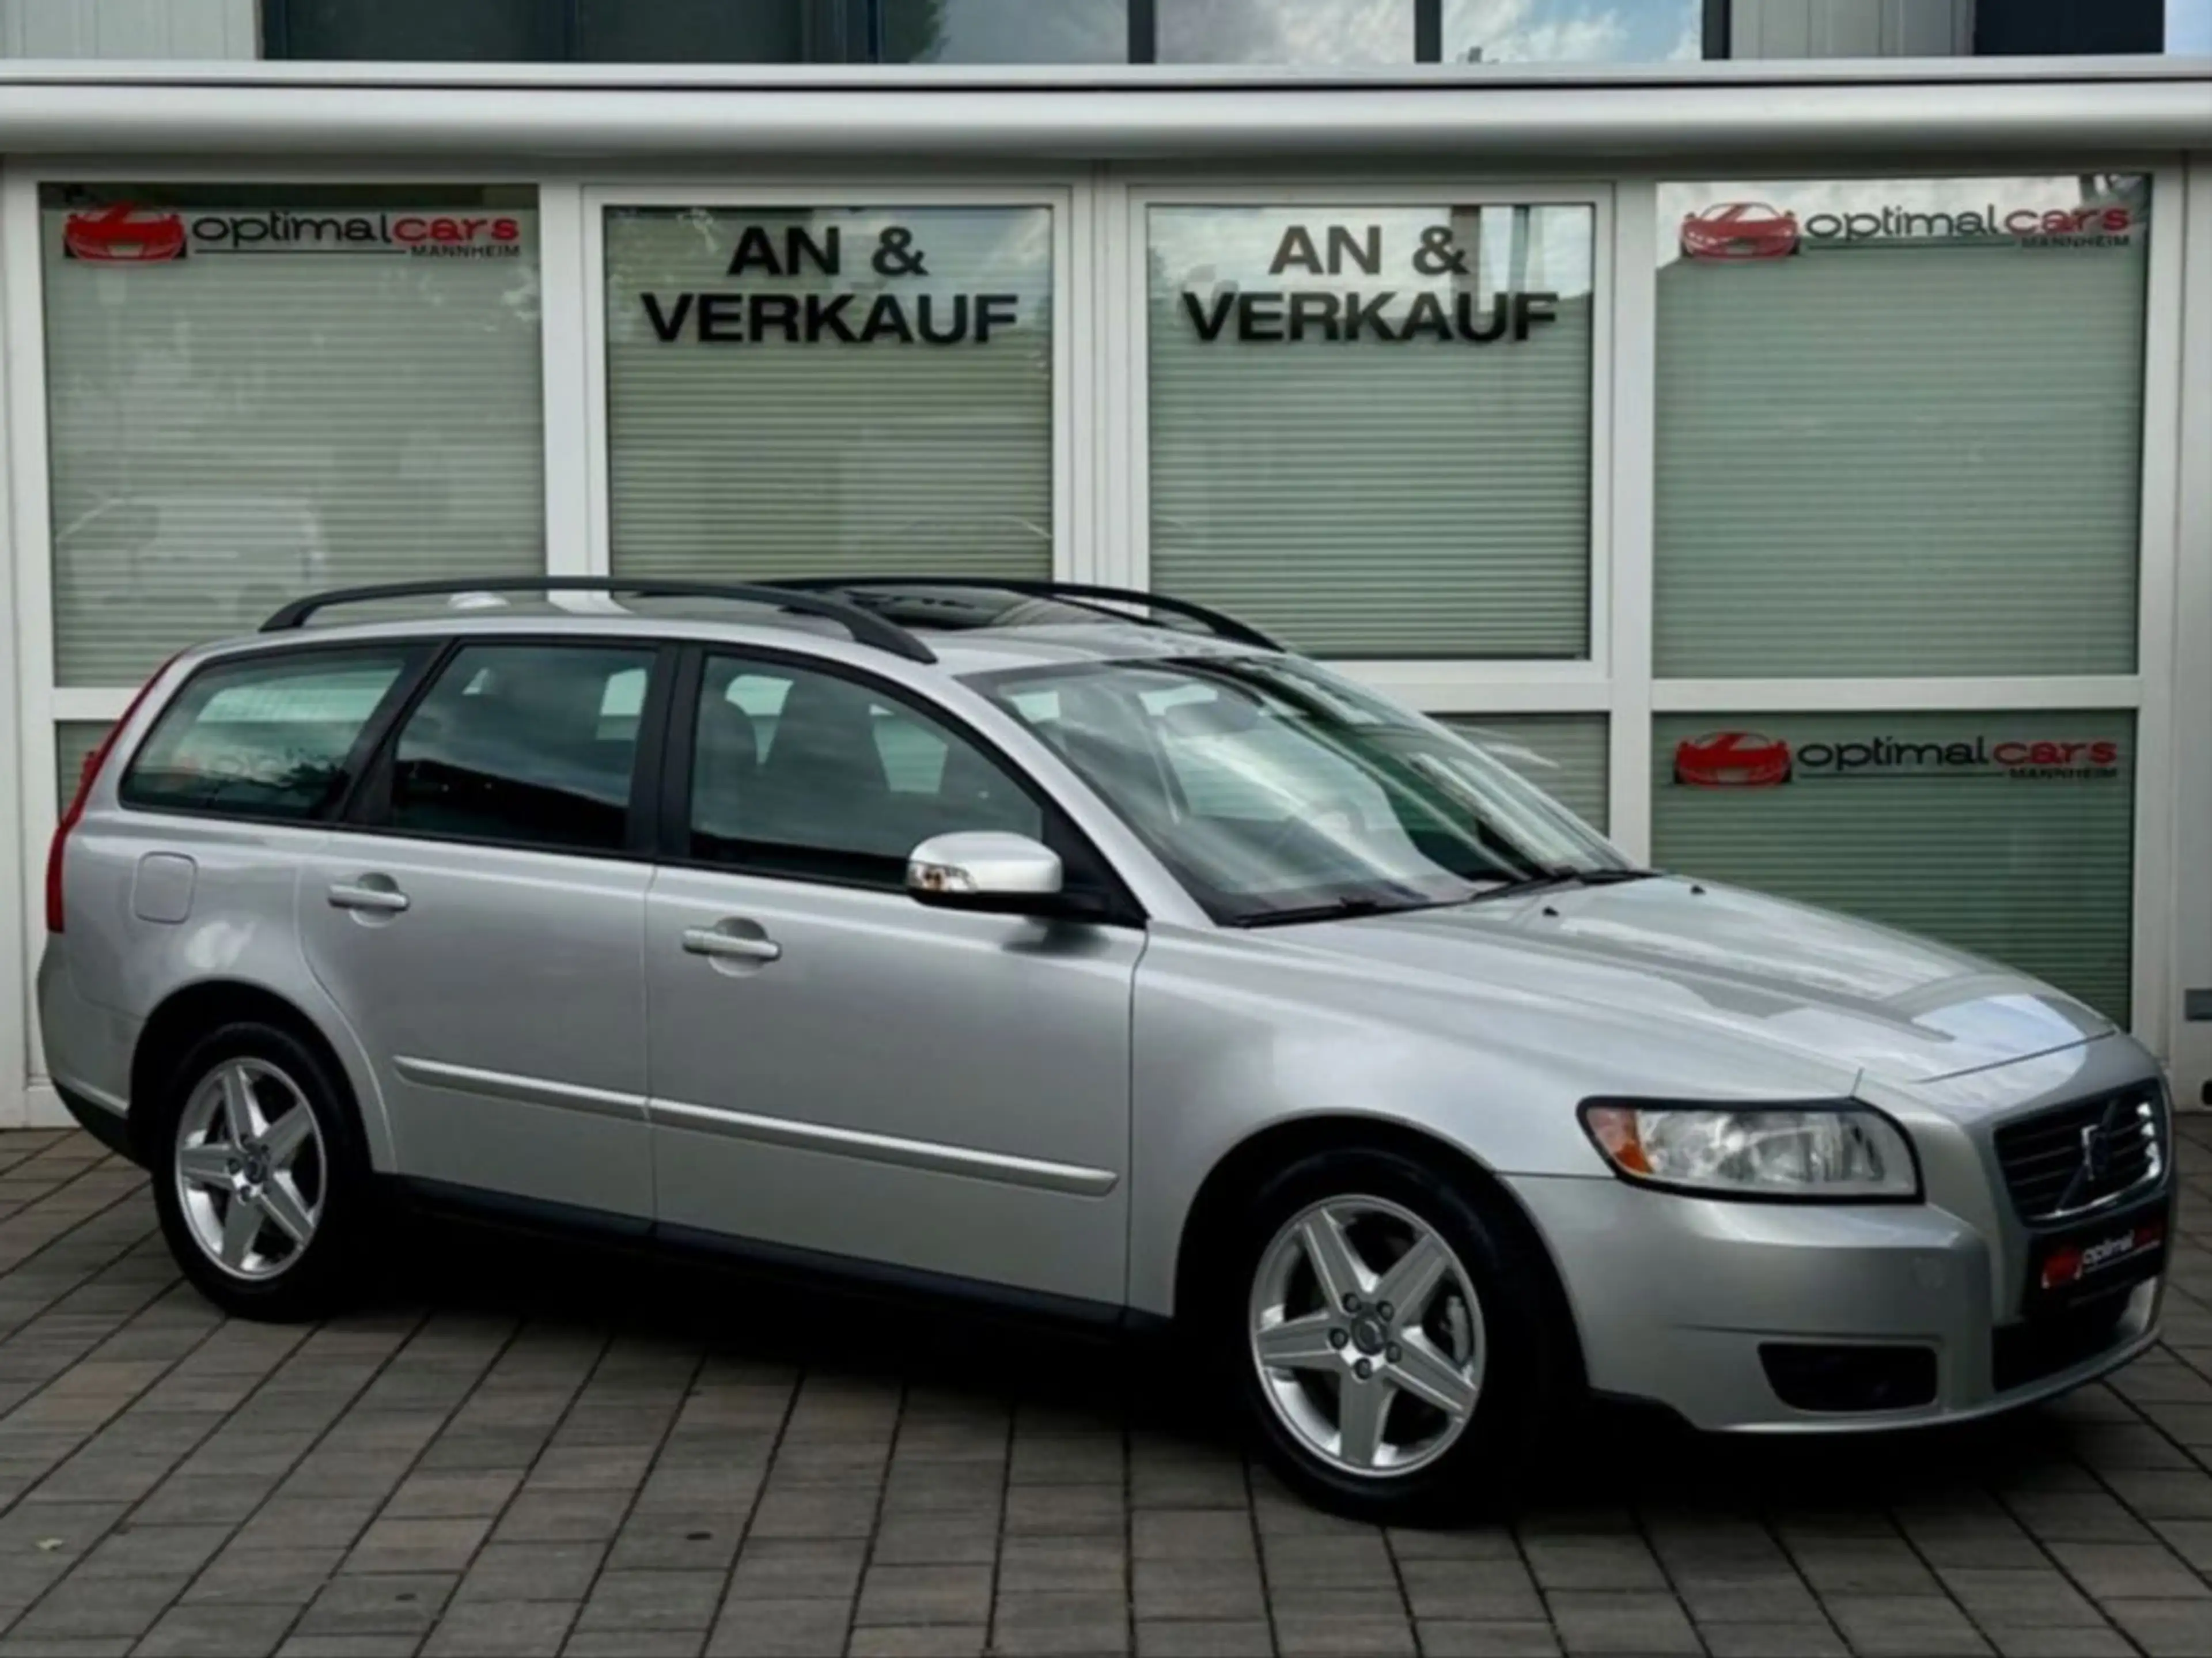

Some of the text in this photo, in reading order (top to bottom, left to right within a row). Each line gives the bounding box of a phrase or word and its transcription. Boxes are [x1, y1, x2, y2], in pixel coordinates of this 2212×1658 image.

[192, 211, 520, 248] optimalcars
[411, 245, 521, 258] MANNHEIM
[727, 225, 929, 277] AN &
[1268, 225, 1470, 276] AN &
[641, 293, 1018, 345] VERKAUF
[1181, 291, 1559, 343] VERKAUF
